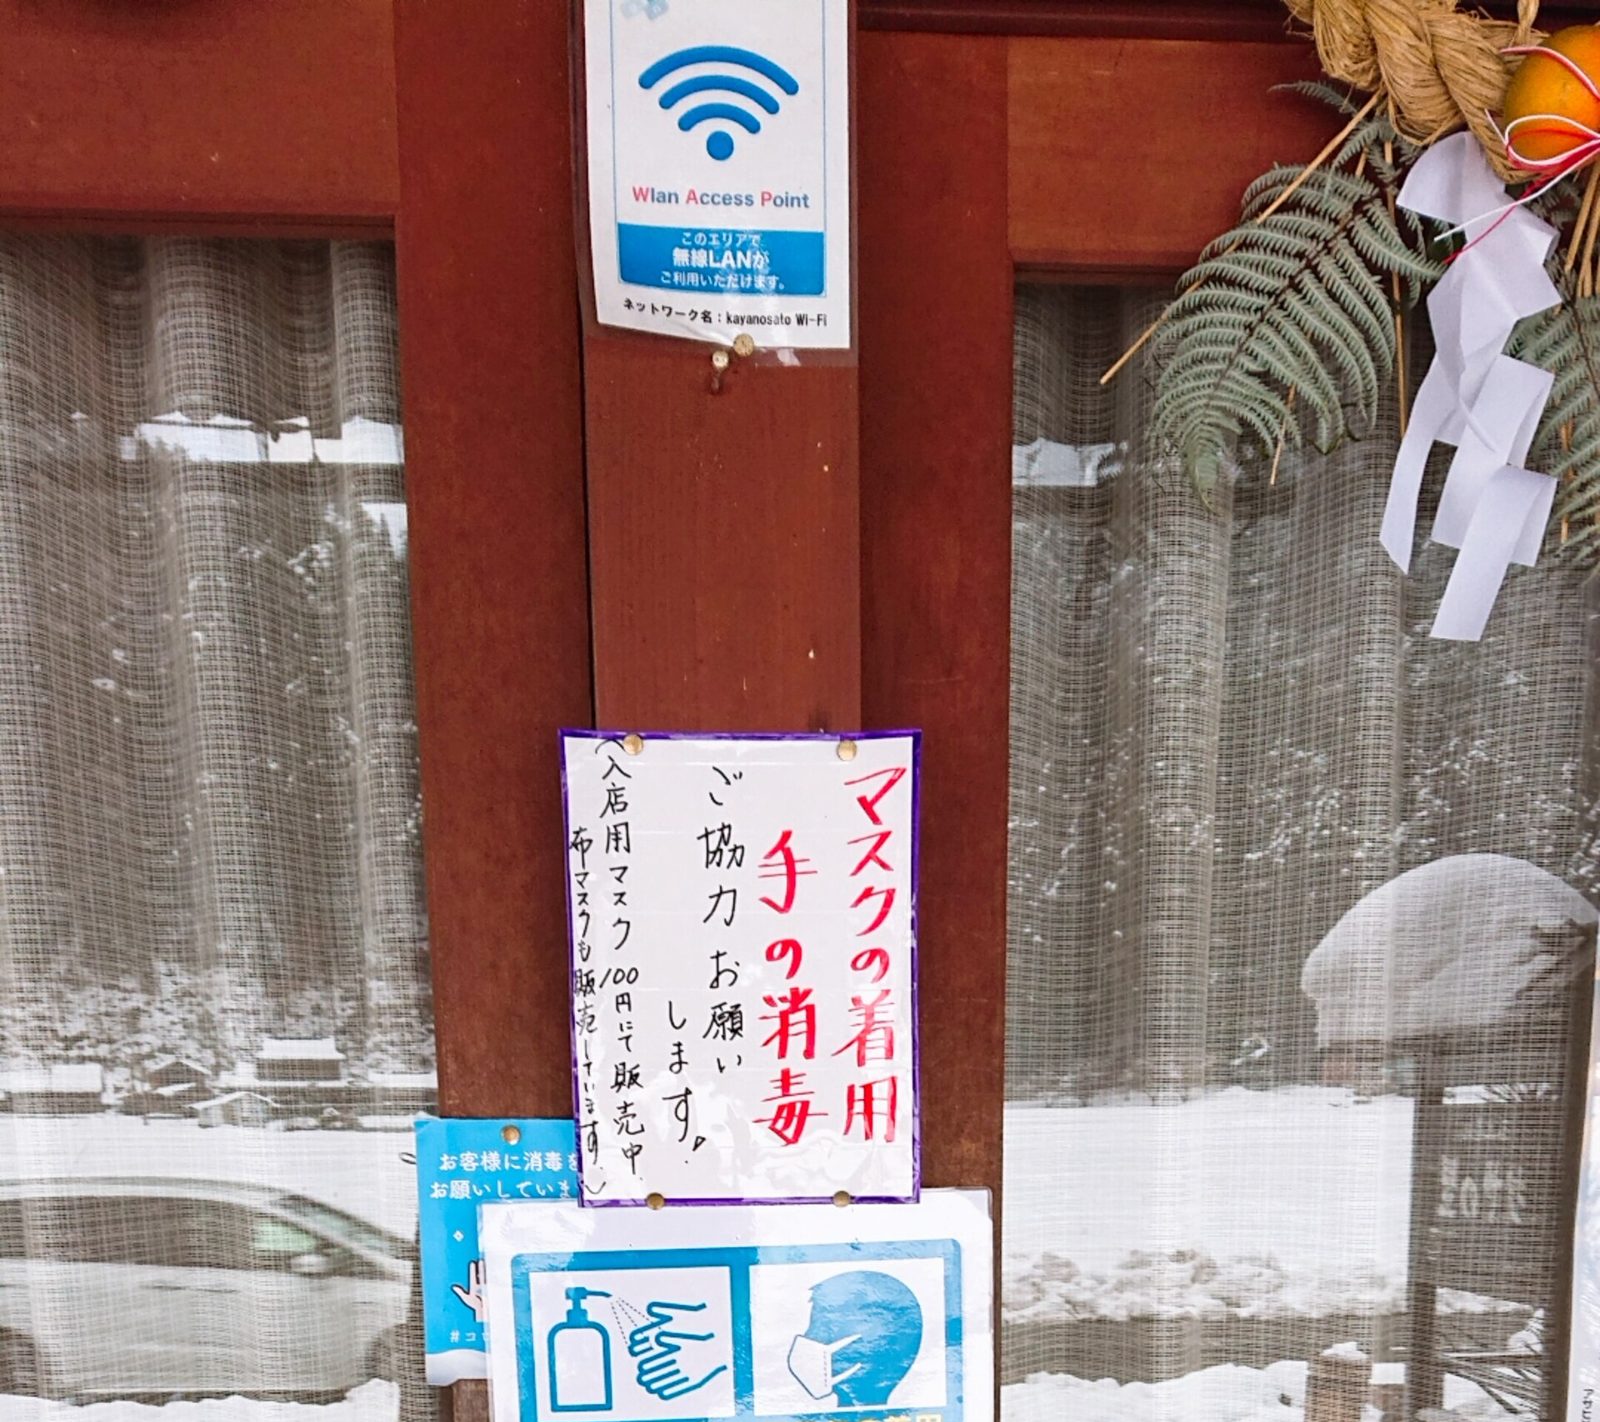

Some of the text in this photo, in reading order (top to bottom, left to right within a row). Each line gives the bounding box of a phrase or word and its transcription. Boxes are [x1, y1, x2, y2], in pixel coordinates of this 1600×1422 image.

[632, 185, 810, 209] Wlan Access Point
[682, 231, 761, 246] このエリアで
[672, 247, 770, 270] 無線LANが
[661, 270, 785, 290] ご利用いただけます。
[796, 313, 828, 327] Wi-Fi
[831, 766, 907, 1144] マスクの着用
[752, 829, 829, 1147] 手の消毒
